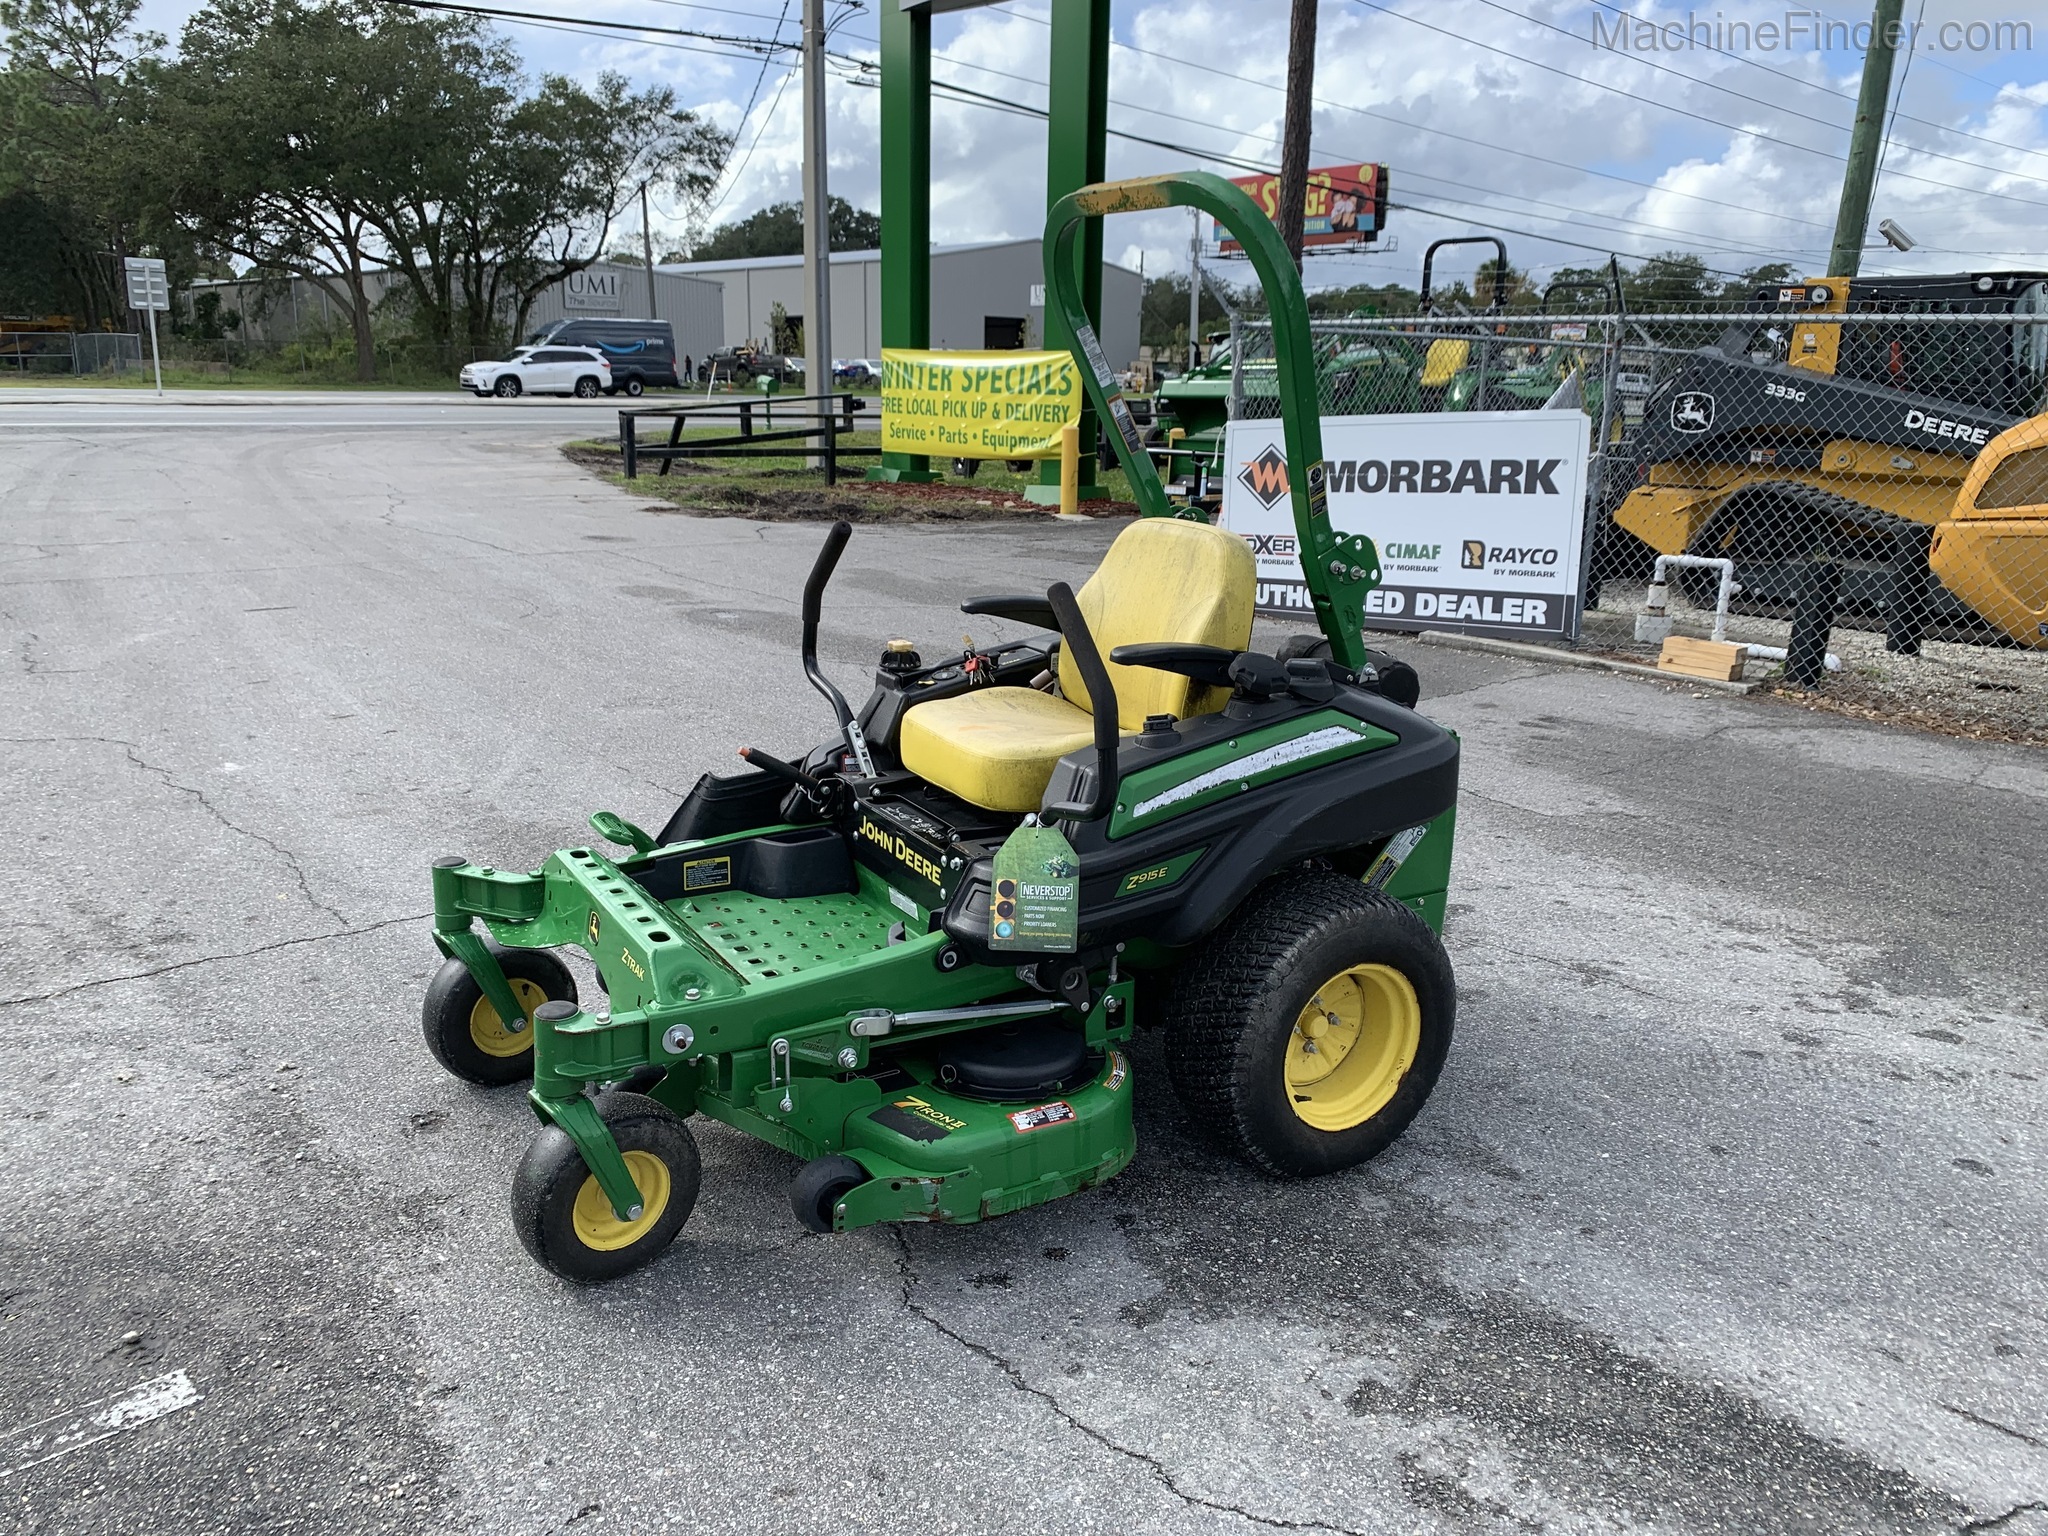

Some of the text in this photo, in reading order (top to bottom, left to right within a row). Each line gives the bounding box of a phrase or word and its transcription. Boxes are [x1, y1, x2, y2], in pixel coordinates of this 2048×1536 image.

[1304, 220, 1325, 231] DITION
[569, 274, 616, 295] UMI
[646, 338, 664, 347] prime
[882, 361, 1072, 407] WINTER SPECIALS
[1765, 383, 1806, 402] 333G
[906, 399, 938, 416] LOCAL
[942, 400, 967, 418] PICK
[972, 402, 987, 418] UP
[992, 402, 1000, 419] &
[1006, 403, 1070, 423] DELIVERY
[889, 422, 1052, 452] Service Parts Equipment
[1904, 409, 1990, 446] DEERE
[1323, 459, 1562, 495] MORBARK
[1385, 543, 1441, 559] CIMAF
[1488, 547, 1558, 565] RAYCO
[1397, 564, 1439, 572] MORBARK
[1508, 569, 1556, 578] MORBARK
[1414, 592, 1547, 624] DEALER
[859, 815, 893, 853] JOHN
[895, 837, 941, 886] DEERE
[1126, 867, 1168, 890] Z915E
[1023, 885, 1070, 896] NEVERSTOP
[621, 948, 645, 981] ZTRAK
